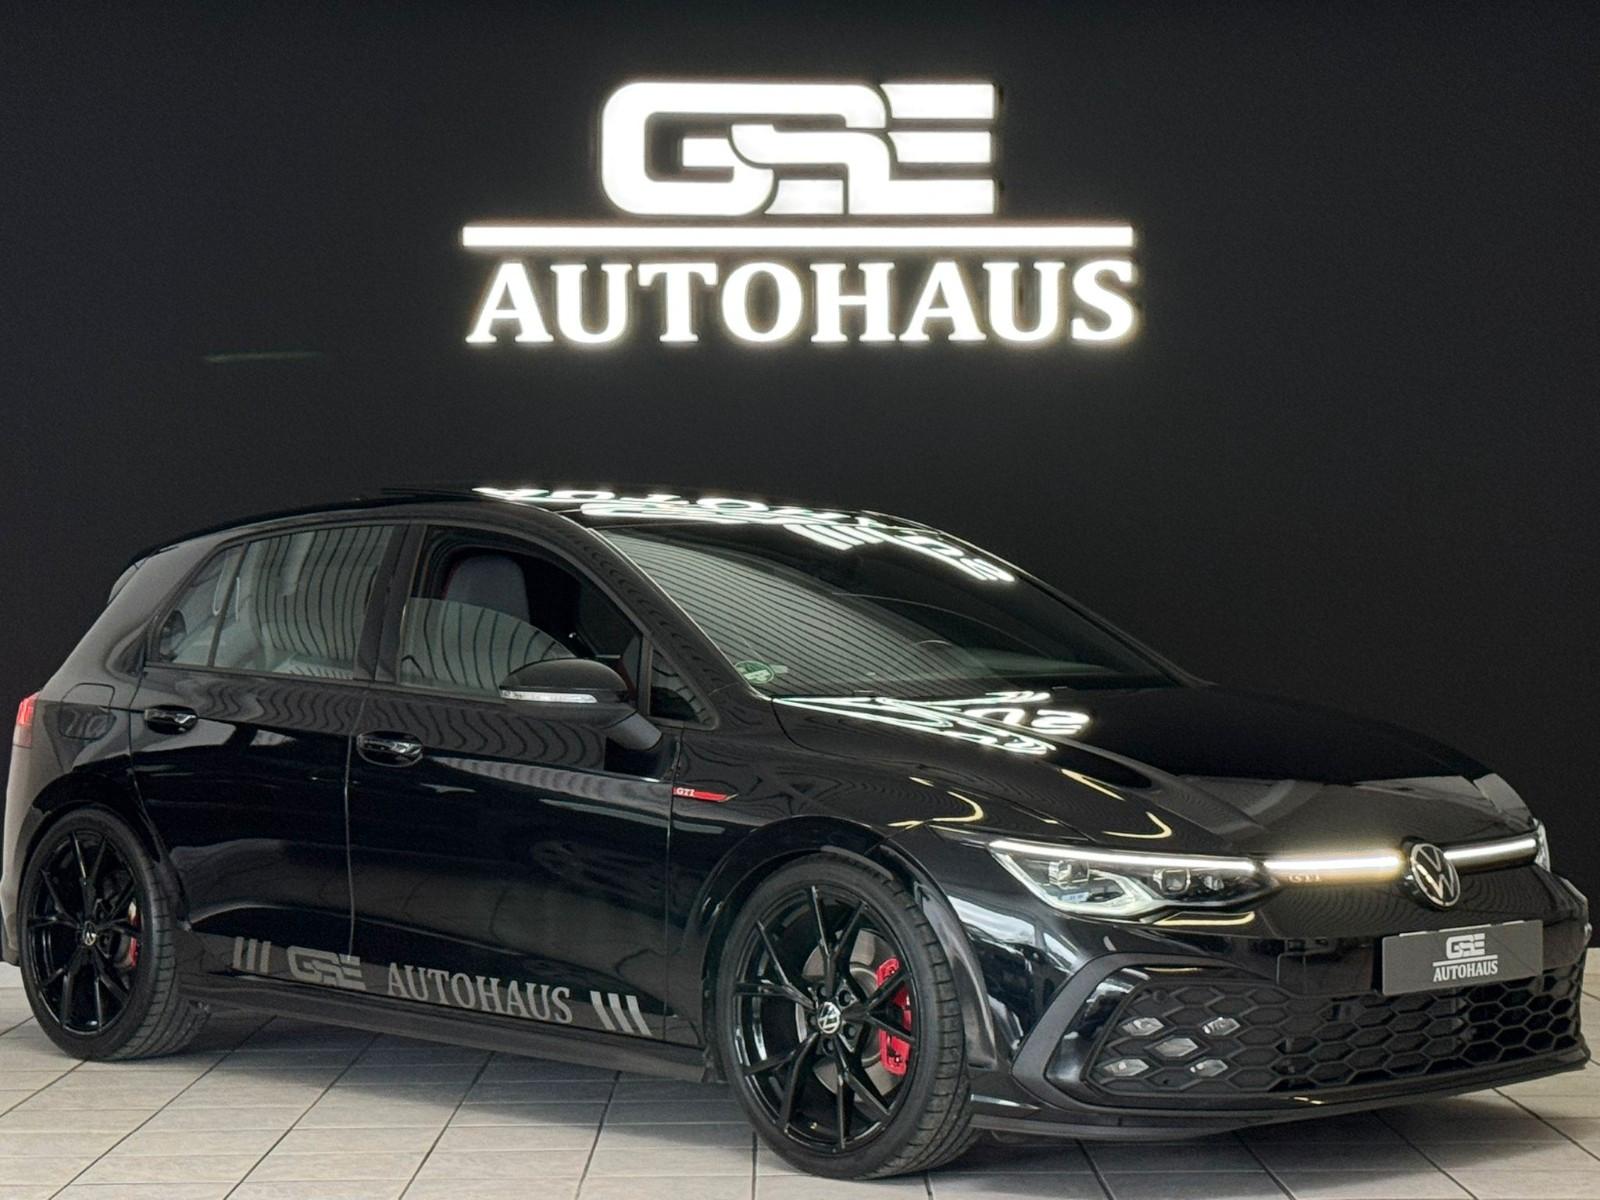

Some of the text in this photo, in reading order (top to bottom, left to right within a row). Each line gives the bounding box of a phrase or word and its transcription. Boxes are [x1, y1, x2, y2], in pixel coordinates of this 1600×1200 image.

[465, 260, 1137, 345] AUTOHAUS
[676, 787, 695, 797] GTI
[1433, 960, 1498, 982] AUTOHAUS
[387, 962, 573, 1025] AUTOHAUS
